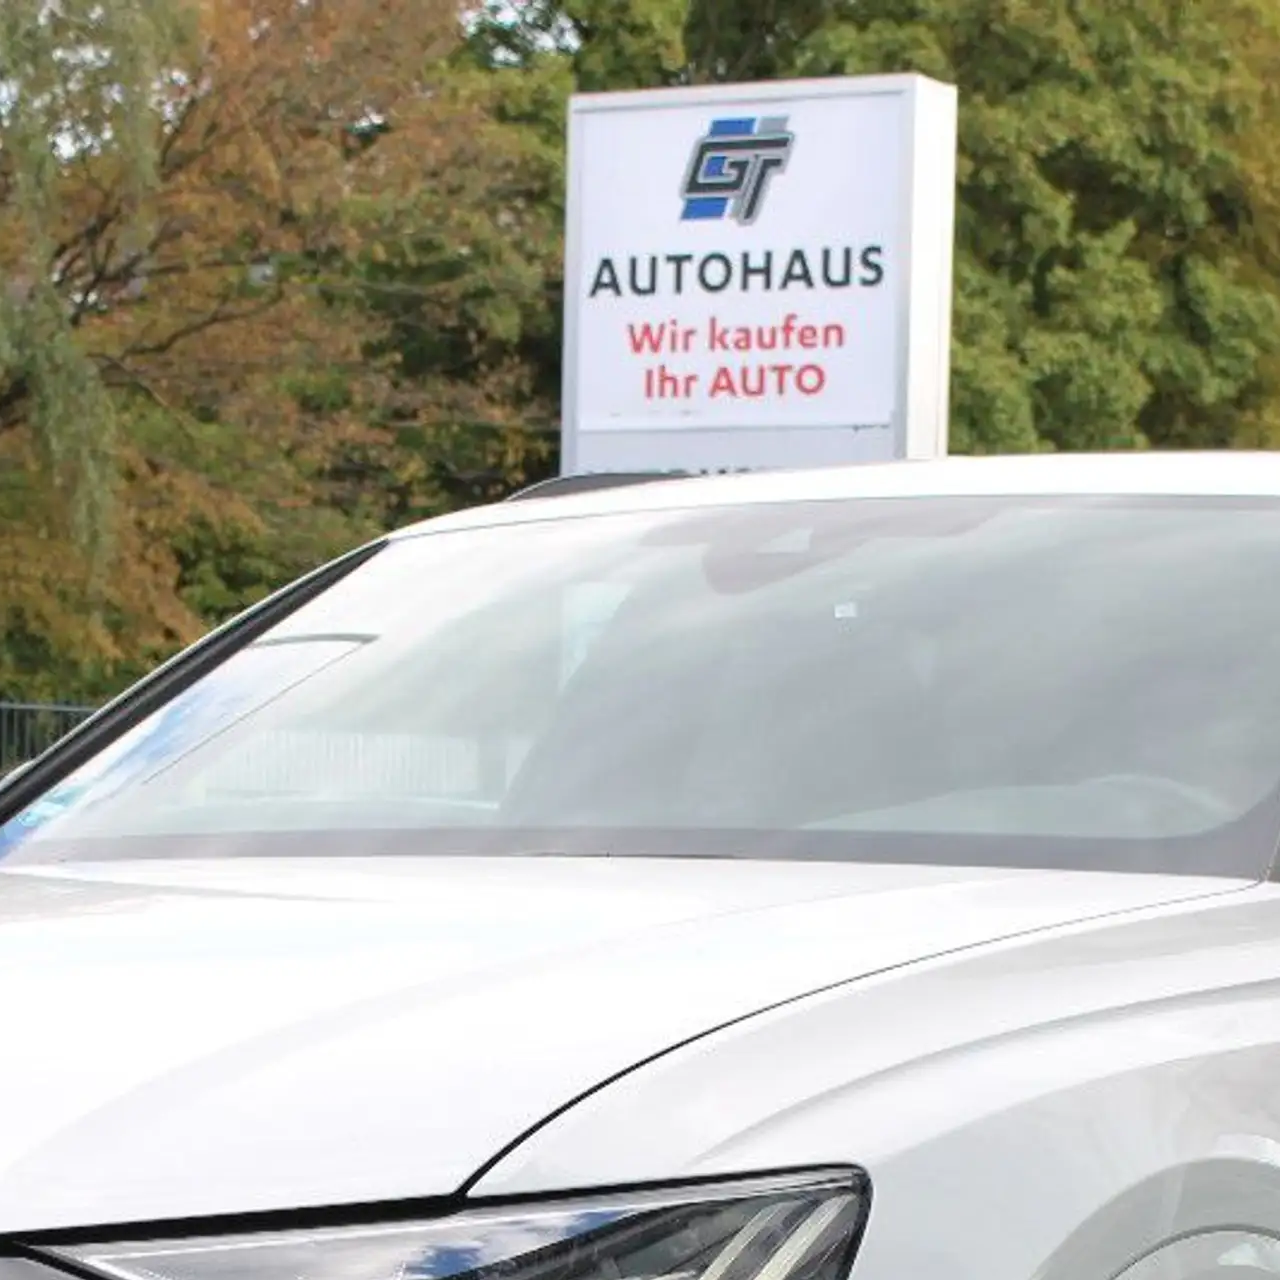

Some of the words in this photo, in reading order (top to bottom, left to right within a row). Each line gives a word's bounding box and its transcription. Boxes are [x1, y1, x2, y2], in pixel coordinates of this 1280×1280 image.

[590, 245, 885, 298] AUTOHAUS
[627, 322, 696, 354] Wir
[708, 314, 845, 352] kaufen
[644, 366, 697, 399] Ihr
[708, 364, 826, 399] AUTO
